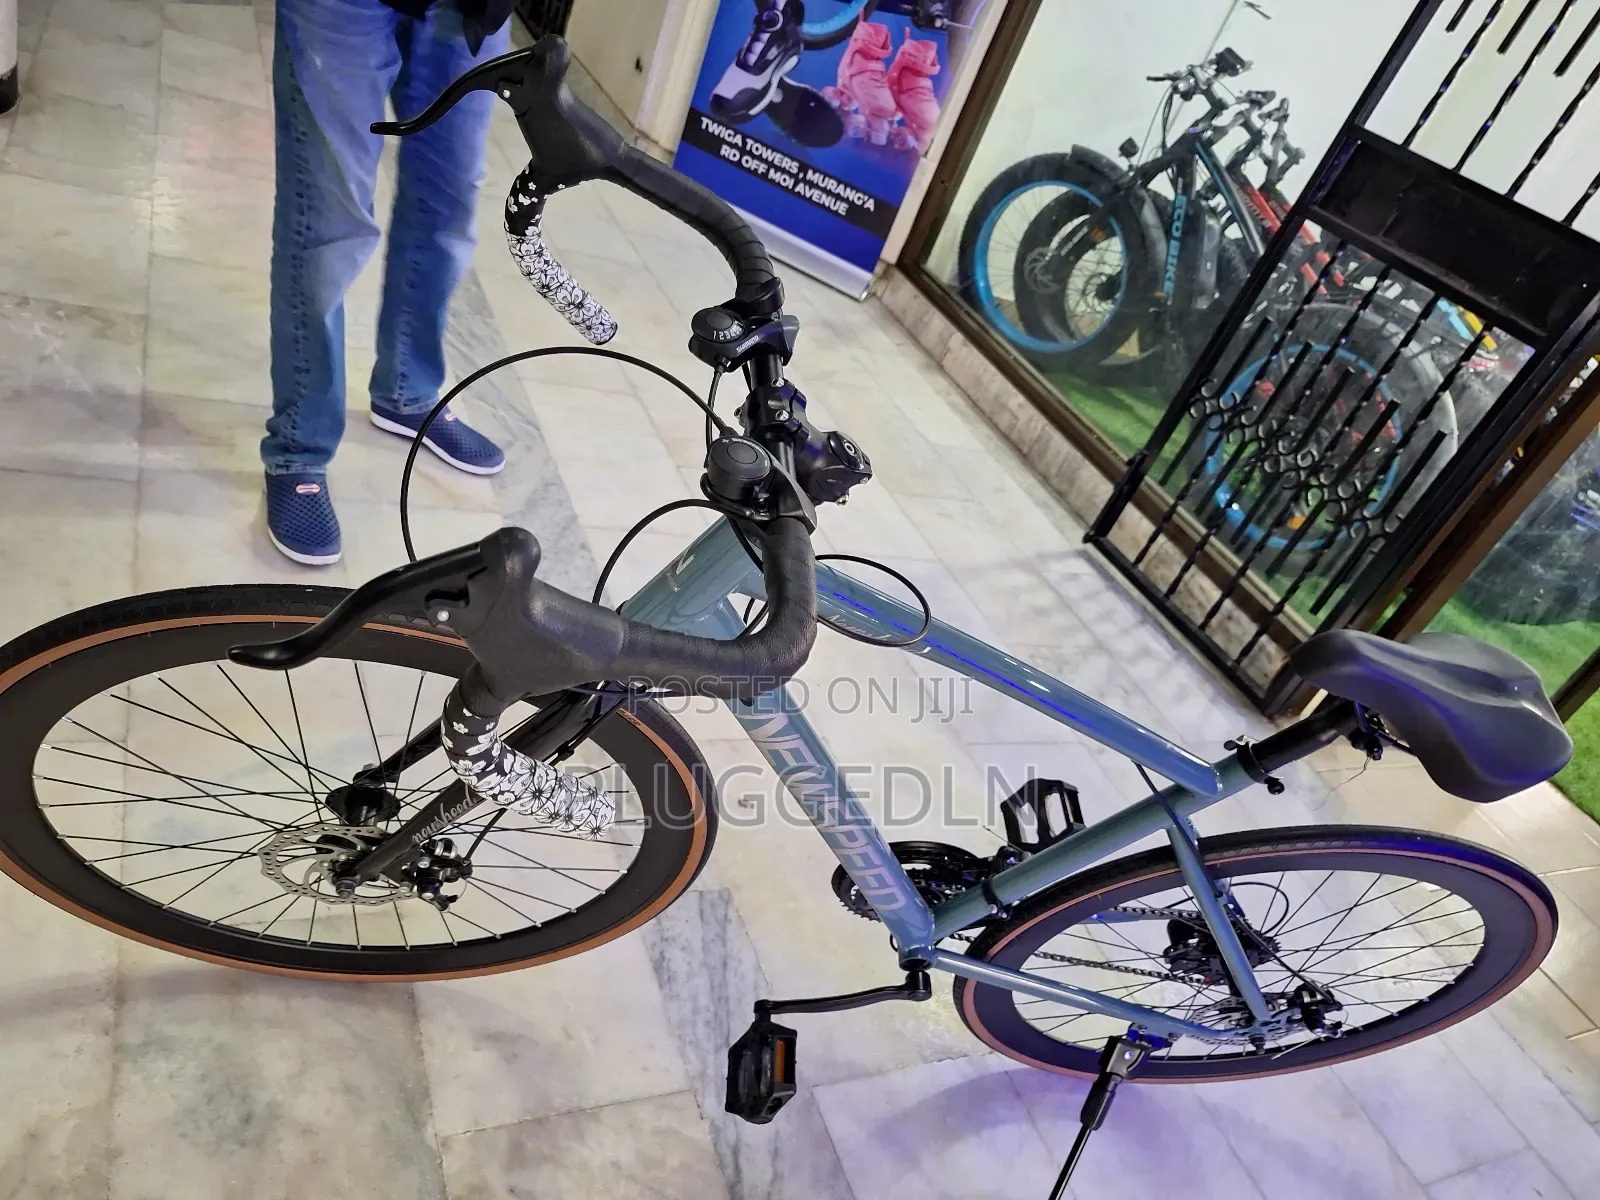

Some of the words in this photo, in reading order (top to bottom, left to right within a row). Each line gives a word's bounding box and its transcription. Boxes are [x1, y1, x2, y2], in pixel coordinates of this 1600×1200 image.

[700, 116, 743, 147] TWIGA
[745, 138, 799, 174] TOWERS
[806, 168, 875, 212] MURANG'A
[720, 145, 740, 163] RD
[741, 157, 768, 175] OFF
[768, 170, 793, 190] MOI
[796, 183, 849, 216] AVENUE
